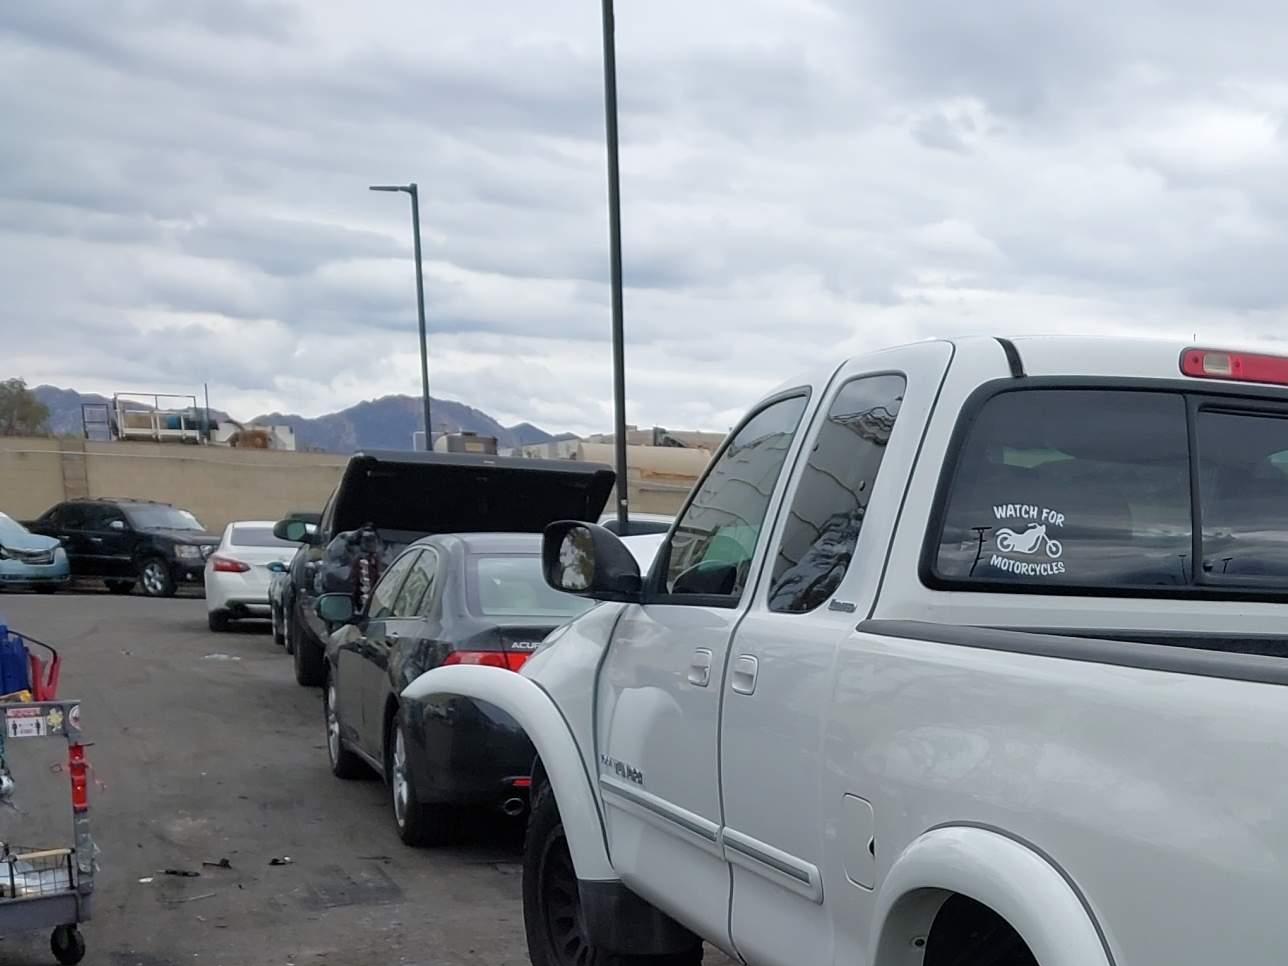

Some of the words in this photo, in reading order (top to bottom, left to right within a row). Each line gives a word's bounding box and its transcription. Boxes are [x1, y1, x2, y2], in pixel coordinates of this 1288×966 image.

[993, 504, 1038, 519] WATCH
[1042, 508, 1065, 527] FOR
[990, 554, 1066, 576] MOTORCYCLES
[511, 641, 541, 649] ACUR
